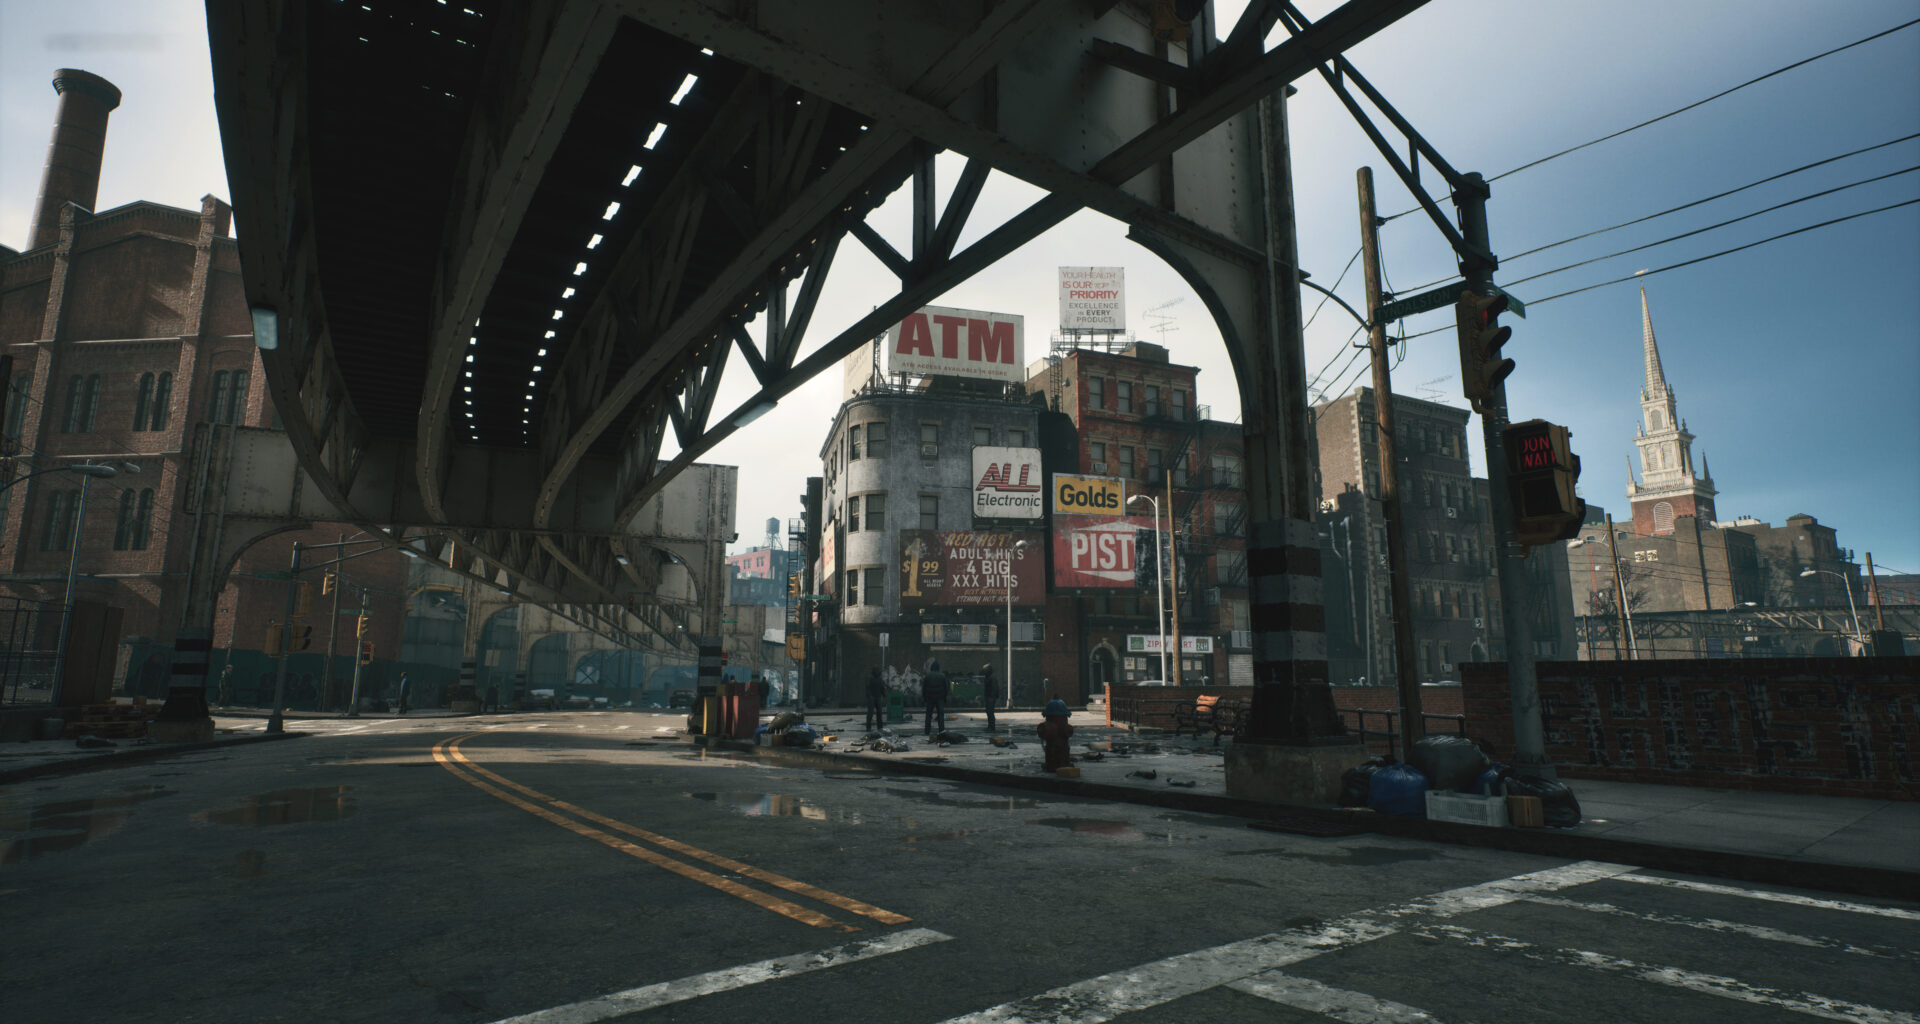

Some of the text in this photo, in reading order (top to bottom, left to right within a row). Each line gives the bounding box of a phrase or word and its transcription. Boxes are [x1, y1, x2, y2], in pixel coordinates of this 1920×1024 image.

[1070, 290, 1118, 299] PRIORITY
[896, 312, 1015, 365] ATM
[975, 463, 1041, 492] ALL
[977, 493, 1040, 507] Electronic
[1060, 484, 1118, 508] Golds
[945, 533, 974, 546] RED
[950, 548, 990, 560] ADULT
[967, 560, 1008, 574] 4 BIG
[952, 575, 1018, 588] XXX HITS
[1147, 640, 1169, 648] ZIP
